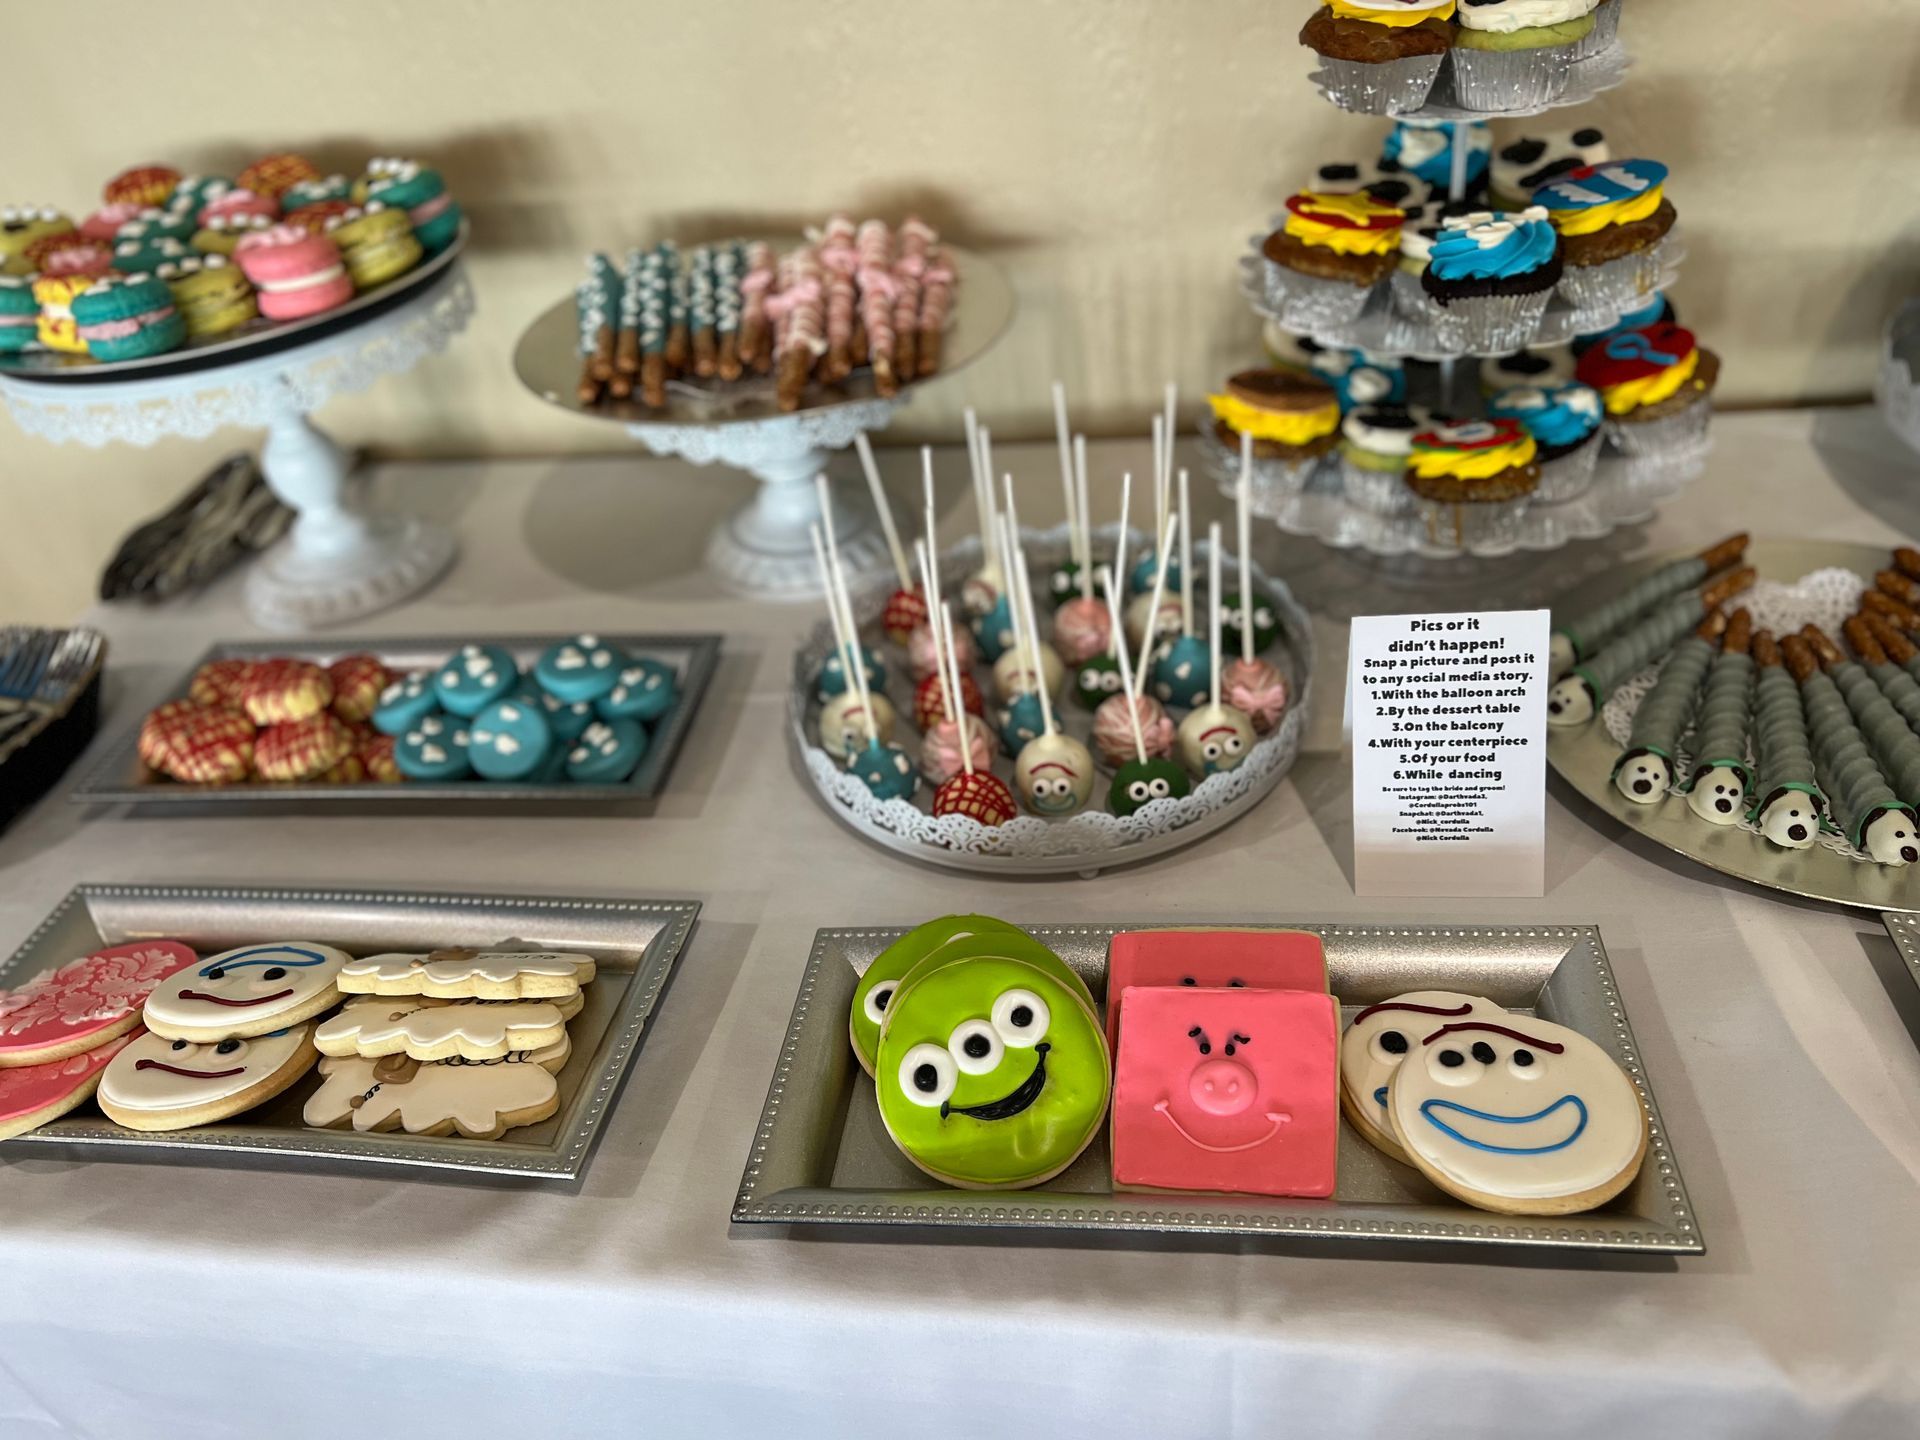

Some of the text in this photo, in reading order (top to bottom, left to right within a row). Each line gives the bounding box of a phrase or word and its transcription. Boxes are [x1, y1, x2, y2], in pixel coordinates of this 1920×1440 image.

[1410, 617, 1480, 632] Pics or it
[1439, 637, 1505, 653] happen!
[1364, 652, 1535, 671] Snap a picture and post it
[1362, 670, 1533, 687] to any social media story.
[1371, 686, 1526, 700] 1.With the balloon arch
[1376, 702, 1521, 719] 2.By the dessert table
[1391, 720, 1505, 733] 3.On the balcony
[1367, 735, 1529, 751] 4.With your centerpiece
[1399, 752, 1496, 767] 5.Of your food
[1392, 768, 1502, 782] 6.While dancing
